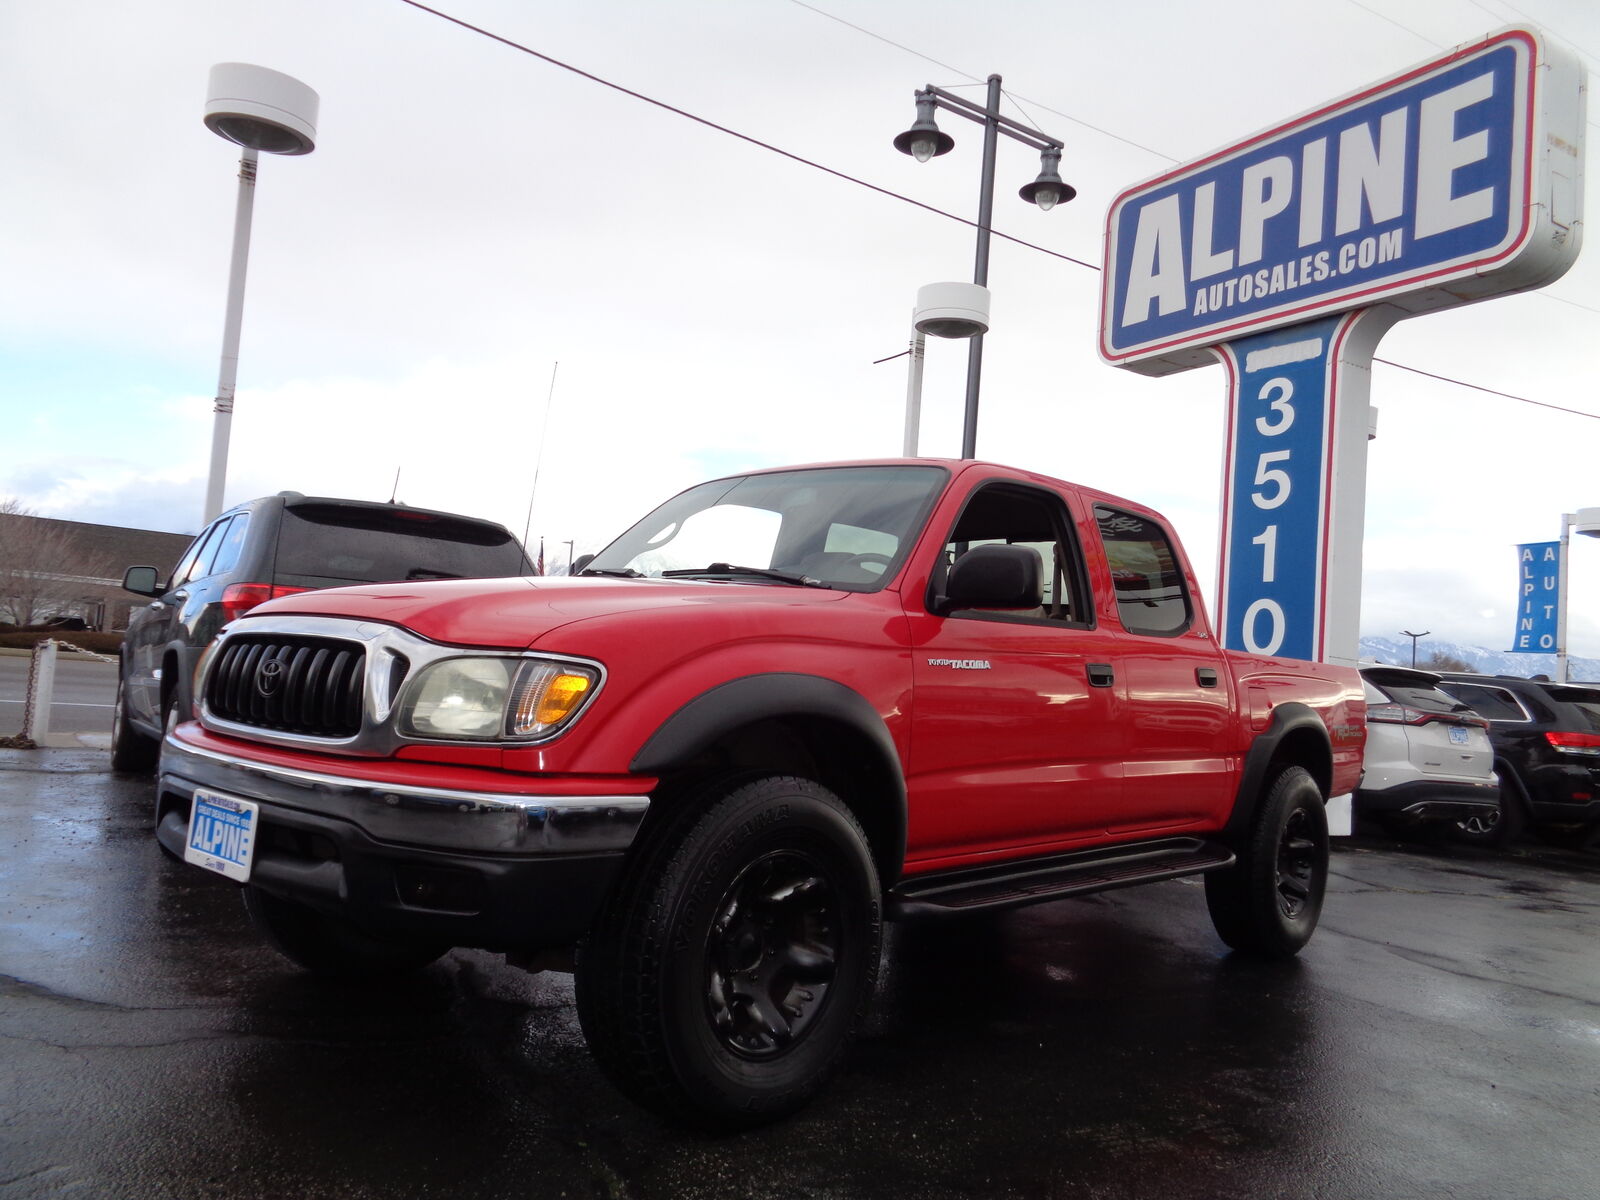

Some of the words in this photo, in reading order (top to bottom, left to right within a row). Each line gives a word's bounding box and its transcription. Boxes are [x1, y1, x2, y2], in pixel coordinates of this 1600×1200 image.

[1122, 71, 1495, 328] ALPINE
[1193, 228, 1403, 316] AUTOSALES.COM
[1520, 548, 1534, 648] ALPINE
[1540, 547, 1555, 648] AUTO
[950, 660, 991, 669] TACOMA
[192, 815, 251, 865] ALPINE
